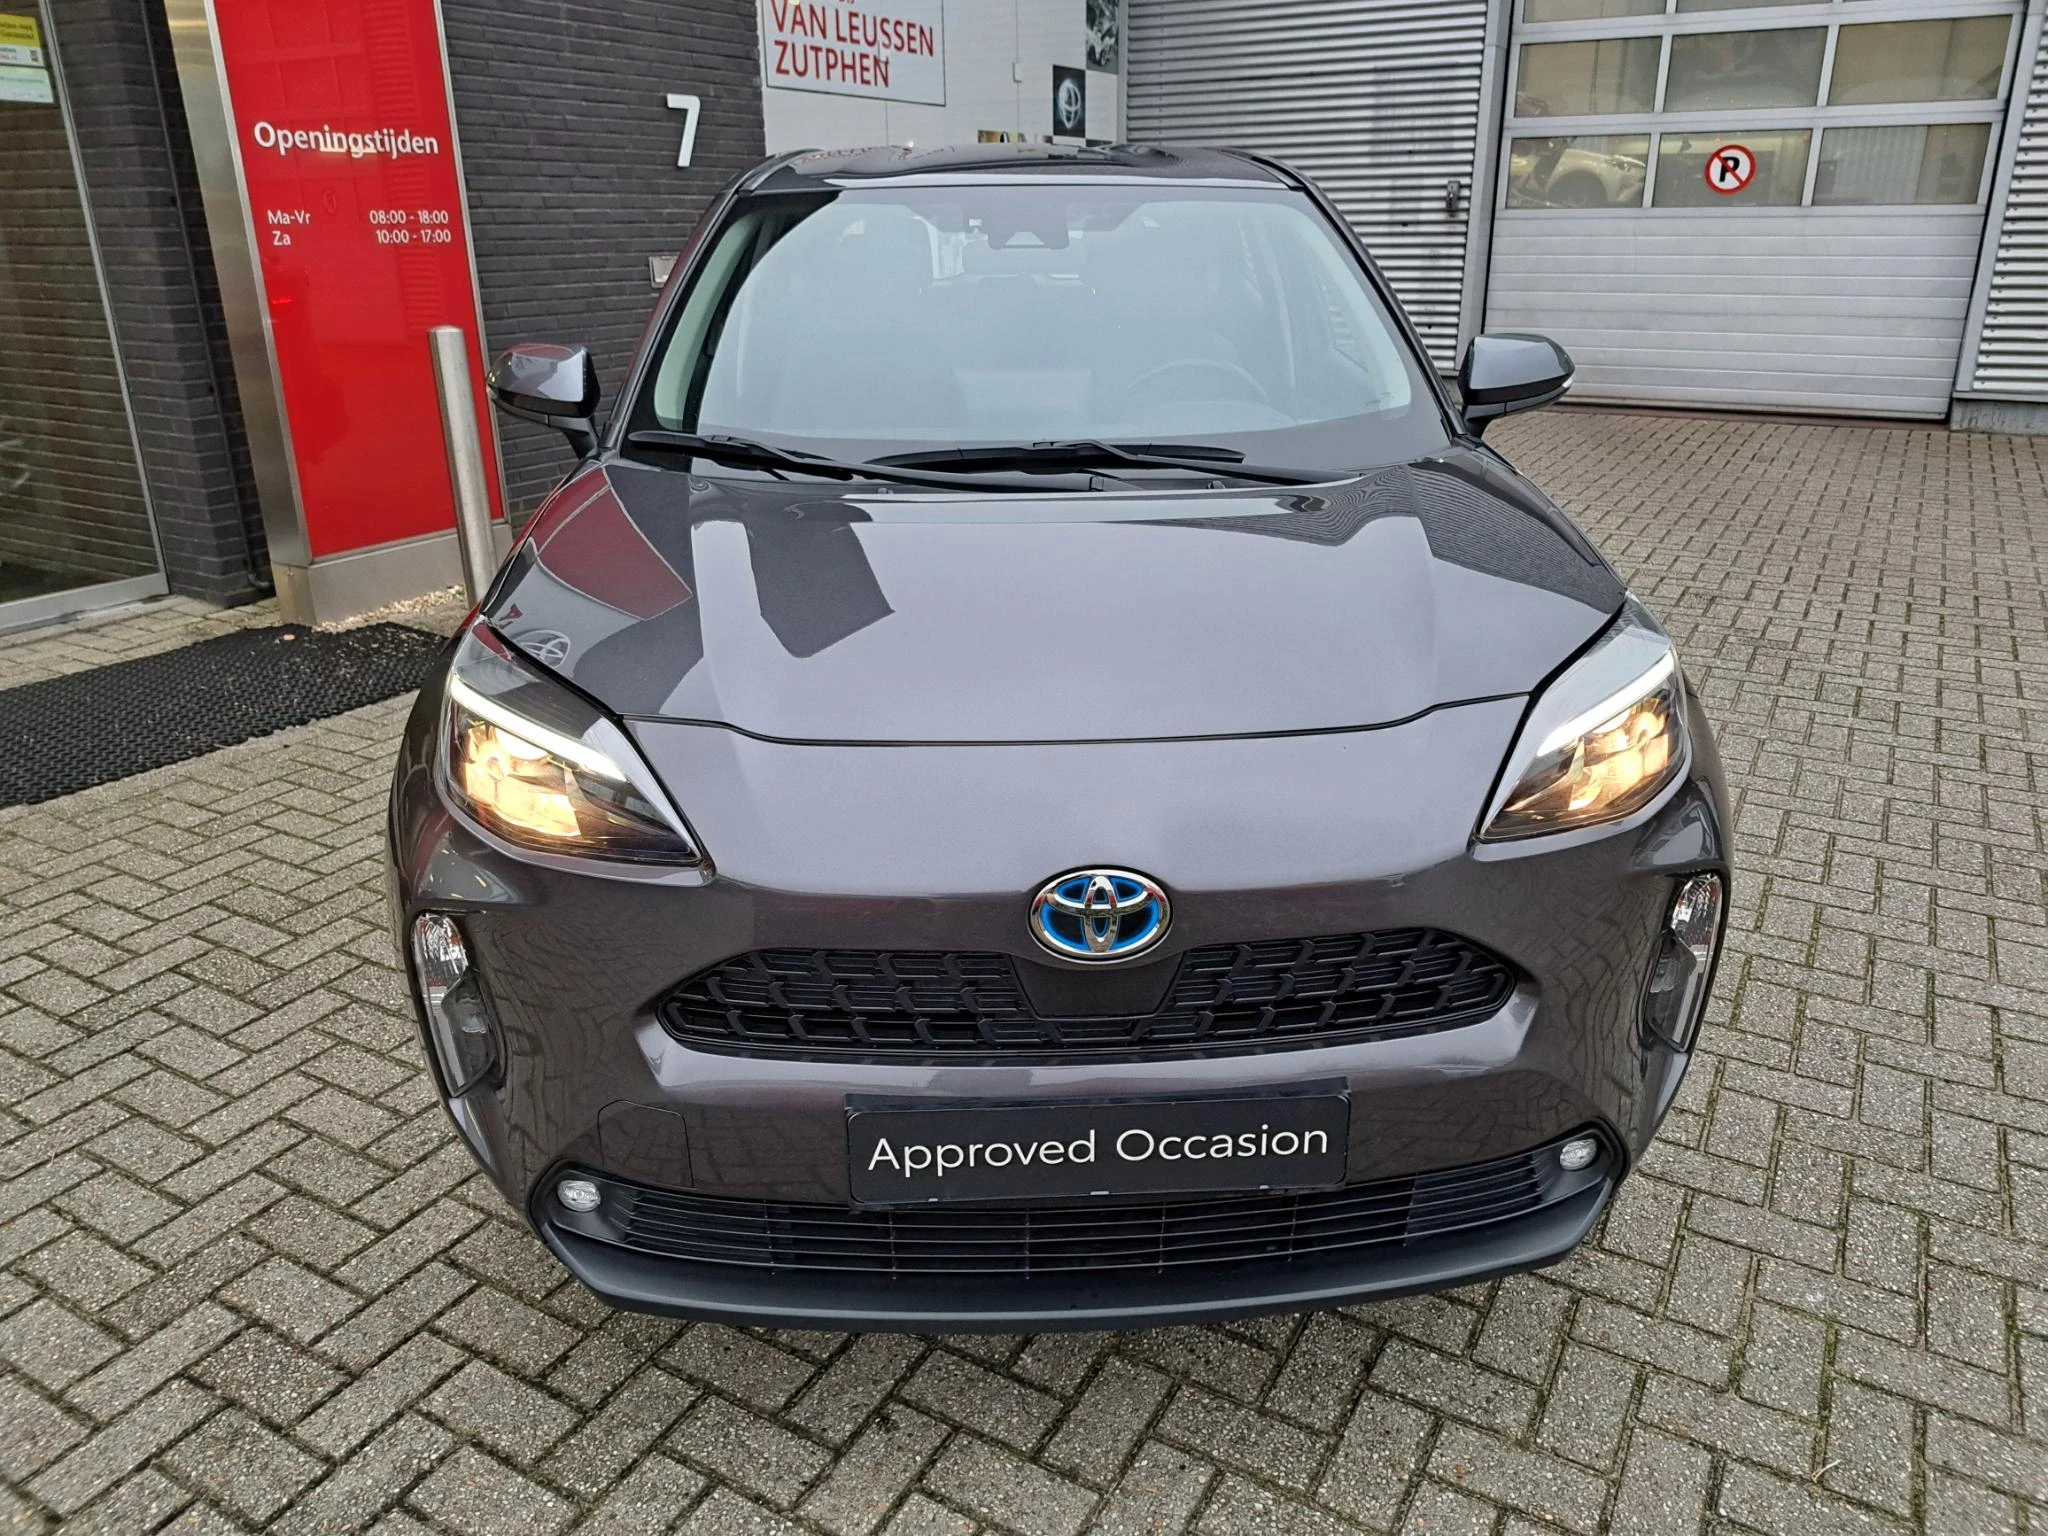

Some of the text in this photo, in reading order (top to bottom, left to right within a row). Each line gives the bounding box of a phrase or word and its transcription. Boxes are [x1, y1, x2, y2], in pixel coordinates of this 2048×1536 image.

[769, 0, 934, 57] VAN LEUSSEN
[774, 40, 889, 88] ZUTPHEN
[254, 121, 439, 159] Openingstijden
[666, 93, 701, 168] 7
[1719, 156, 1740, 183] P
[267, 210, 311, 225] Ma-Vr
[369, 210, 406, 225] 08:00
[416, 210, 449, 225] 18:00
[272, 231, 291, 246] Za
[376, 230, 409, 244] 10:00
[420, 229, 451, 243] 17:00
[867, 1124, 1328, 1177] Approved Occasion
